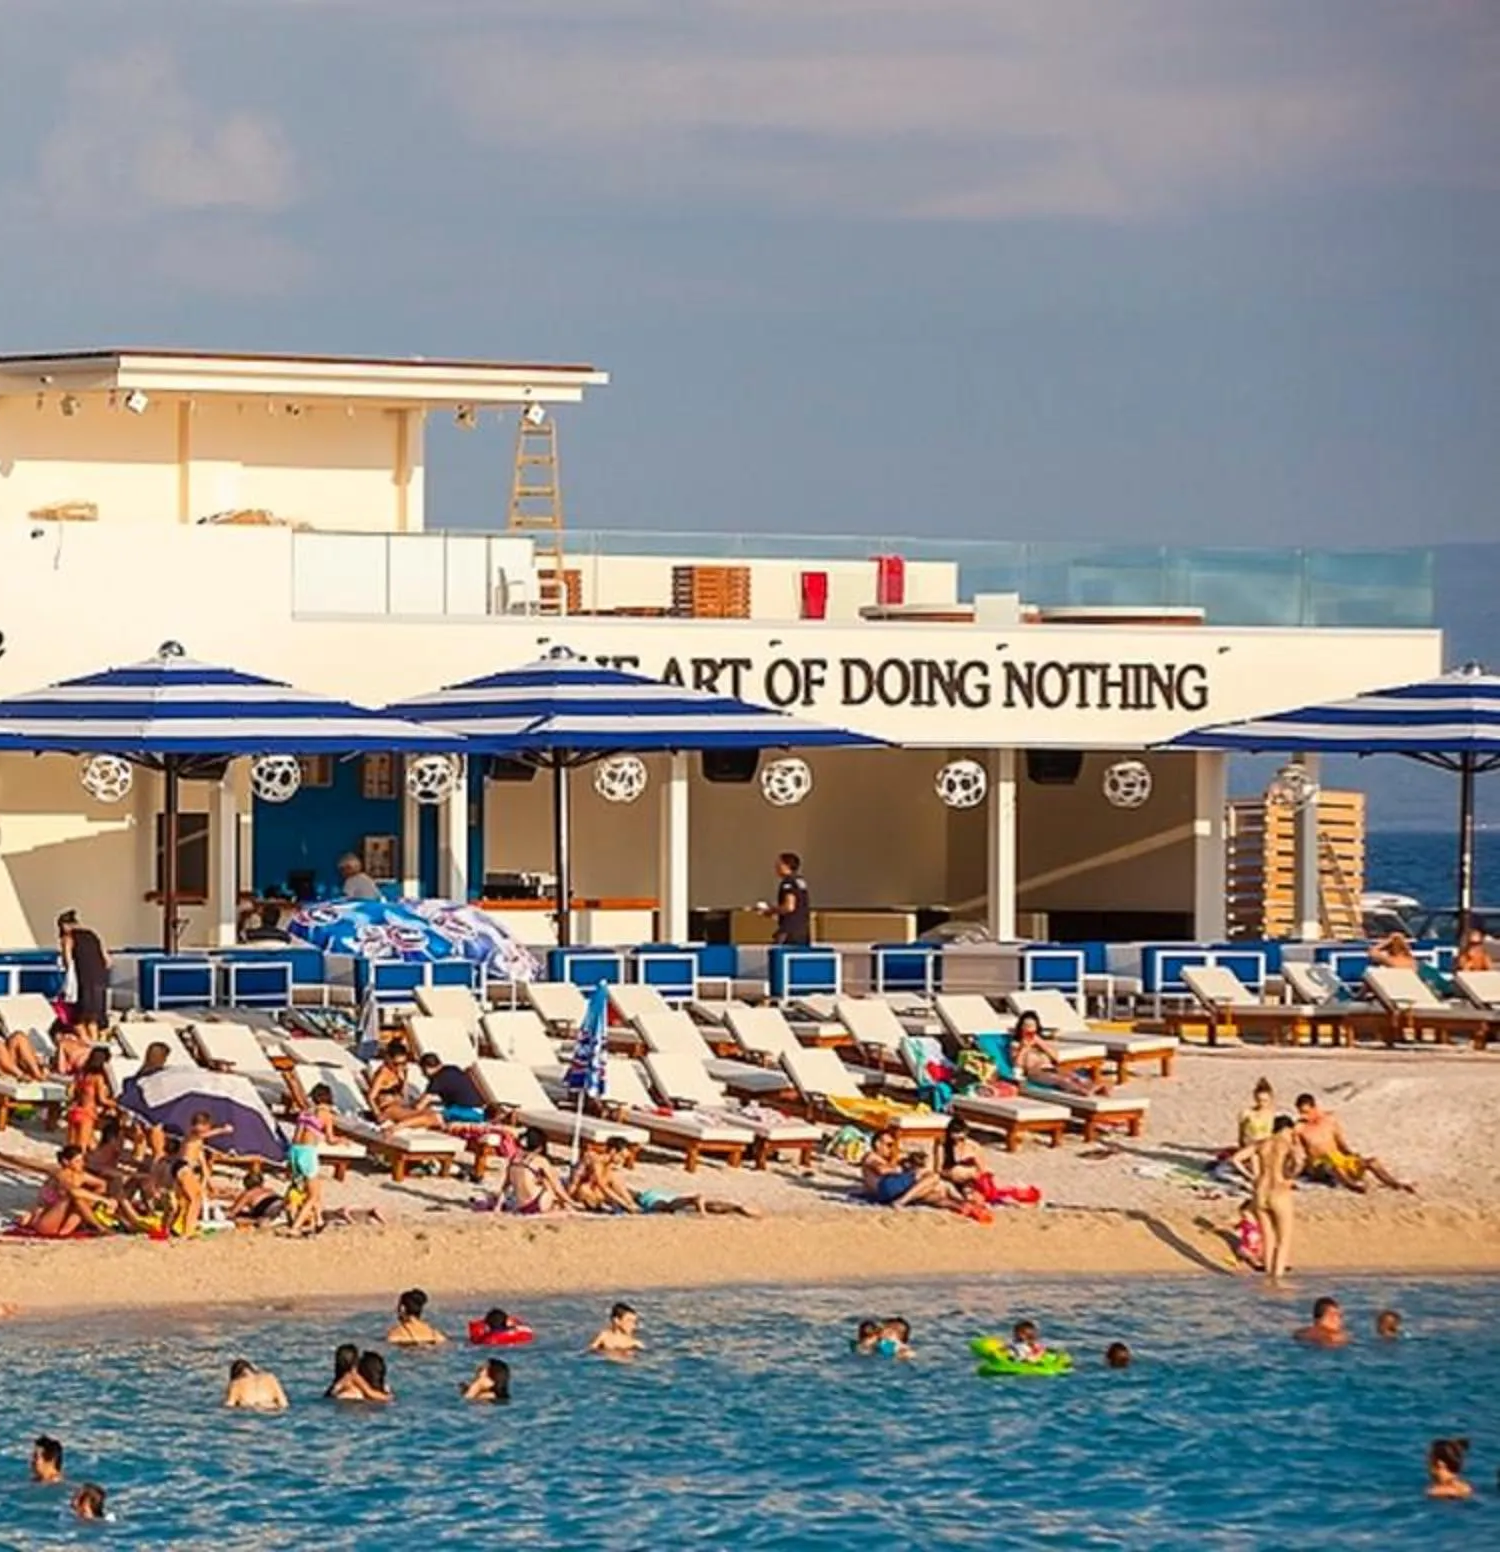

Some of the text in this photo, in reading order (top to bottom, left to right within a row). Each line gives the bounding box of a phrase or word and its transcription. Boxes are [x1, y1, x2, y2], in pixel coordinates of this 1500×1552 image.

[662, 656, 1209, 711] ART OF DOING NOTHING
